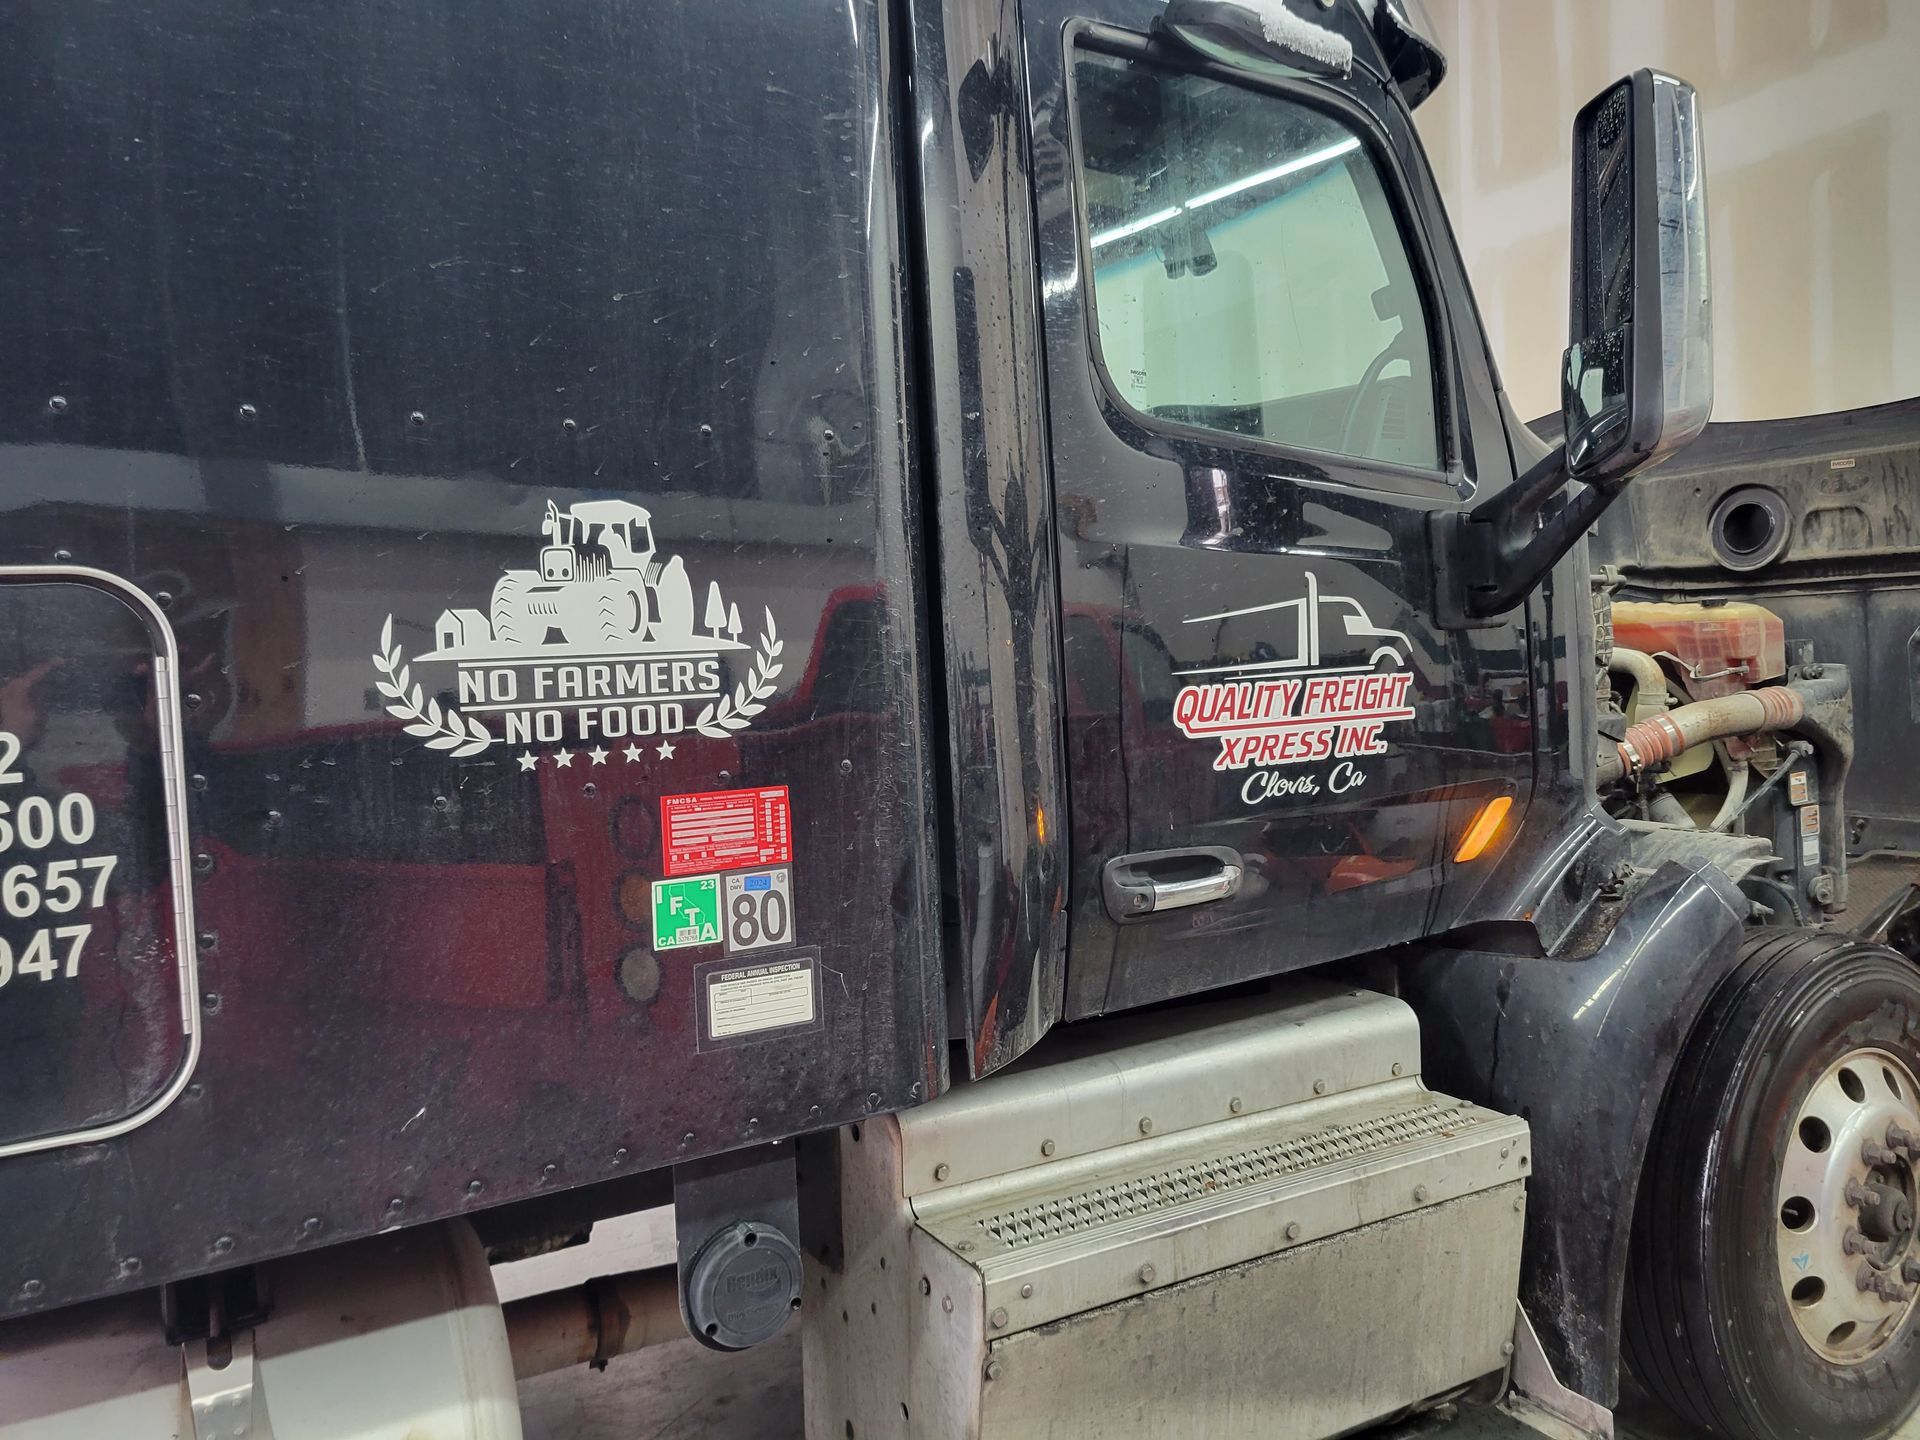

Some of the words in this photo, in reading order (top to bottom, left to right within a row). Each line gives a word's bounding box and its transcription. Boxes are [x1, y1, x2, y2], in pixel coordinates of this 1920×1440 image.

[458, 668, 517, 704] NO
[534, 660, 721, 700] FARMERS
[1174, 681, 1301, 728] QUALITY
[1303, 675, 1413, 717] FREIGHT
[505, 709, 563, 745] NO
[579, 703, 685, 740] FOOD
[1215, 728, 1333, 768] XPRESS
[1337, 724, 1387, 754] INC.
[667, 797, 698, 806] FMCSA
[1241, 770, 1320, 804] Clovis,
[1328, 762, 1366, 793] Ca
[2, 855, 118, 918] 657
[700, 880, 715, 891] 23
[732, 890, 787, 947] 80
[658, 936, 676, 946] CA
[721, 972, 746, 981] FEDERAL
[747, 969, 769, 978] ANNUAL
[769, 962, 801, 974] INSPECTION
